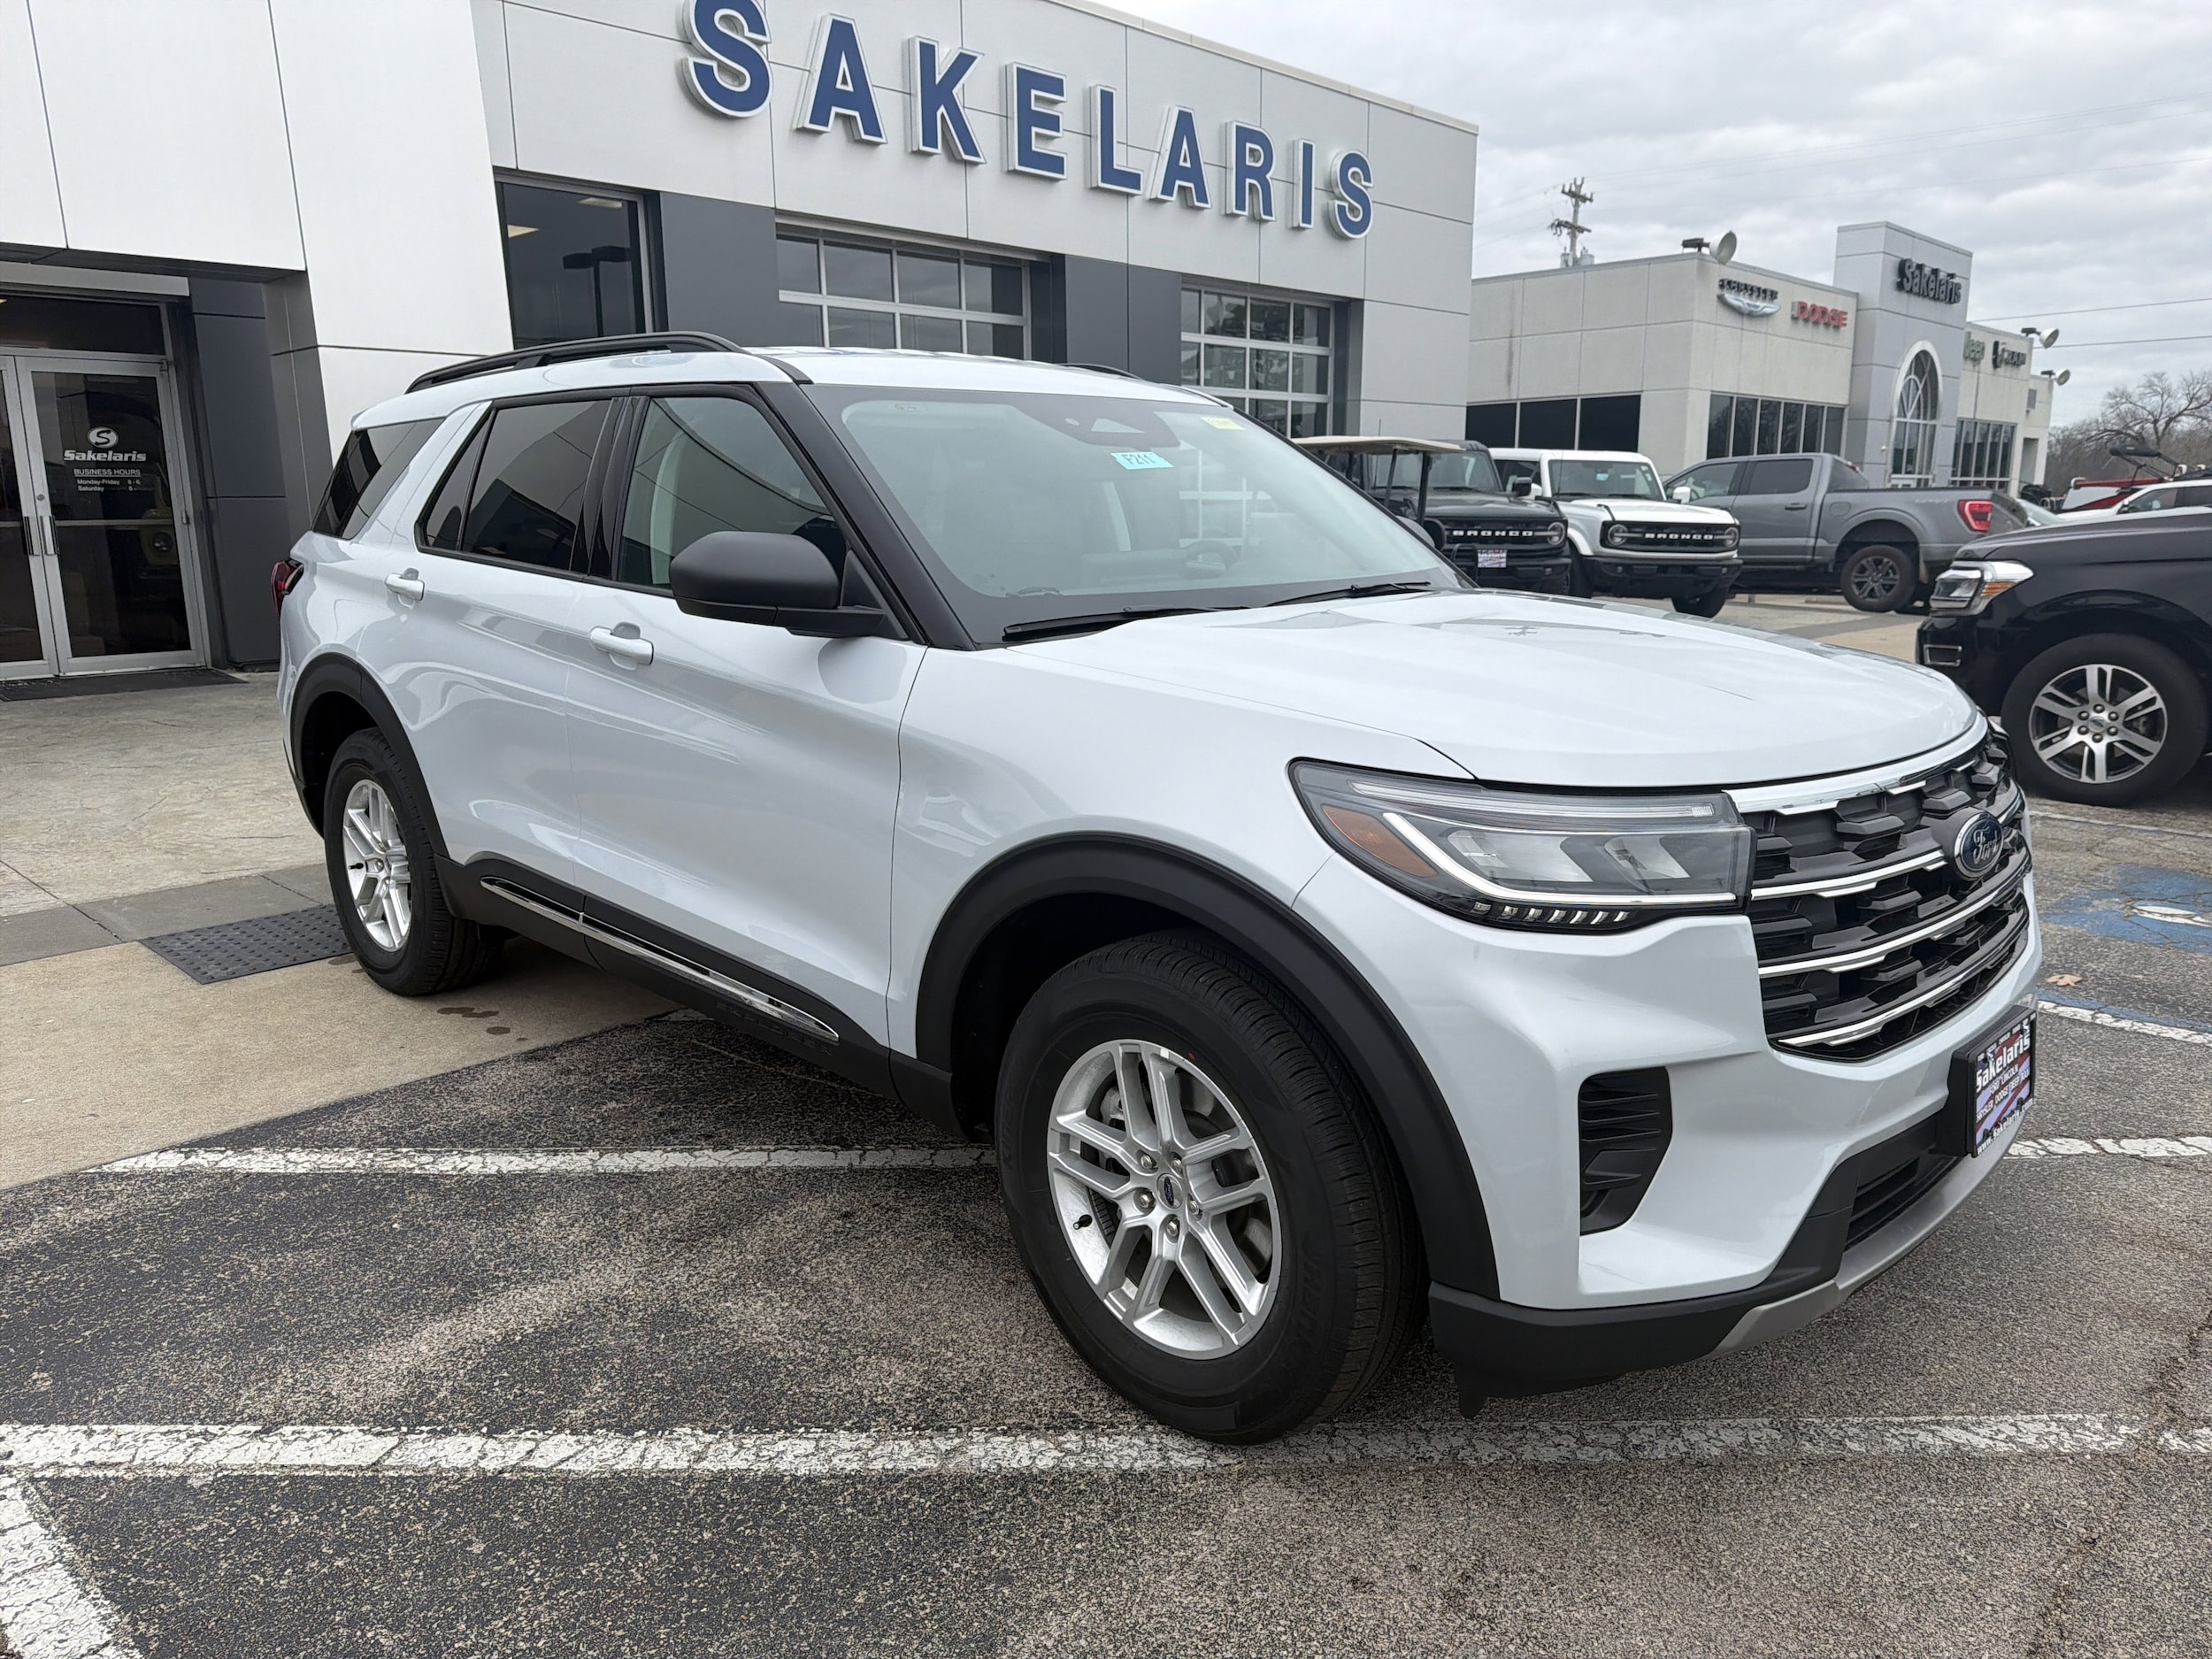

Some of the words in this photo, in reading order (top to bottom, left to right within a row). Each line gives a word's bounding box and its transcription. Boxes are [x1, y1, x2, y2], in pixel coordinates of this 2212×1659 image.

[683, 0, 1373, 241] SAKELARIS
[1897, 258, 1962, 304] Sakelaris
[1793, 301, 1848, 327] DODGE
[64, 449, 147, 461] Sakelaris
[1973, 826, 1998, 864] Ford
[1976, 1033, 2031, 1094] Sakelaris
